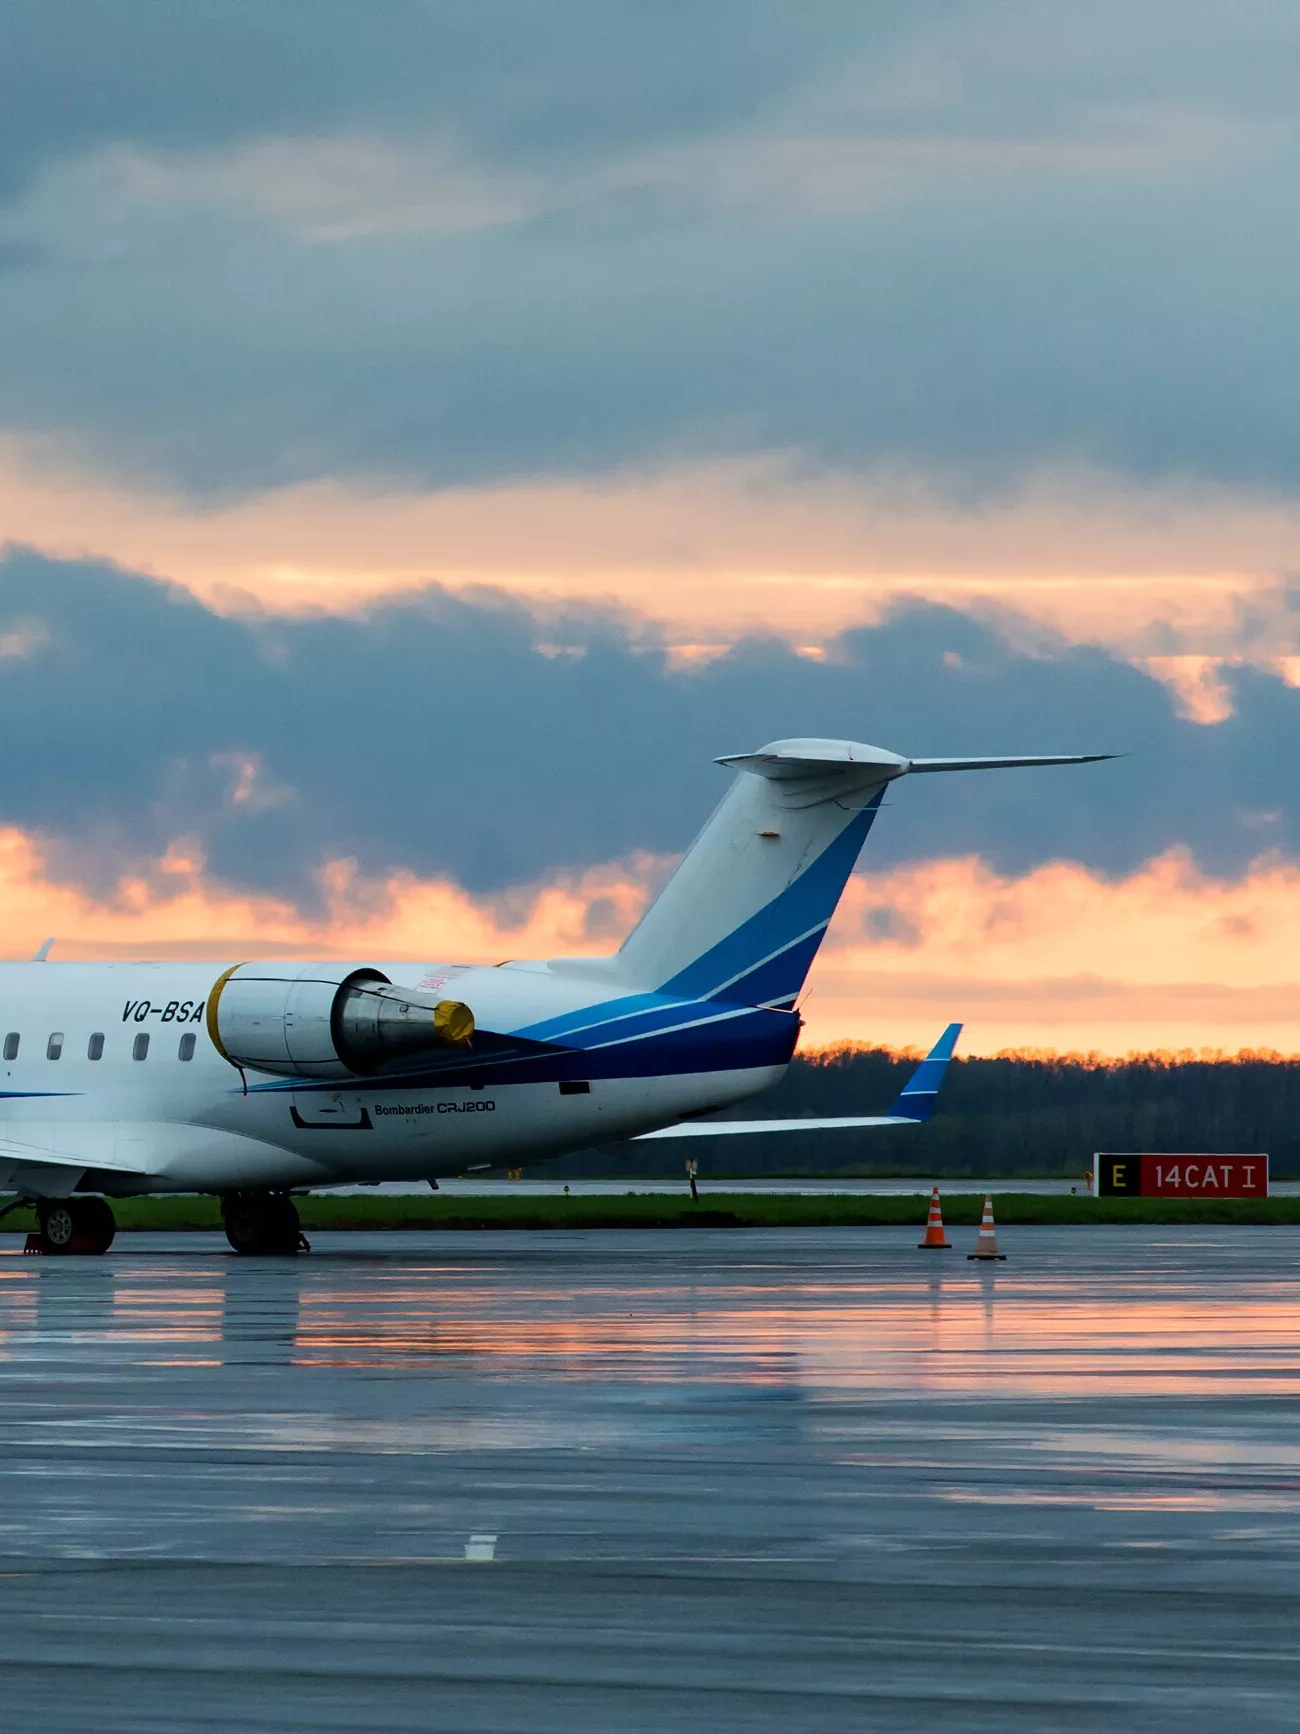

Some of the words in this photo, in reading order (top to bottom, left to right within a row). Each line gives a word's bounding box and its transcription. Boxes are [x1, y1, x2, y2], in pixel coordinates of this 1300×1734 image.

[122, 1000, 206, 1023] VQ-BSA
[374, 1104, 435, 1116] Bombardier
[436, 1100, 496, 1114] CRJ200
[1112, 1164, 1127, 1188] E
[1242, 1165, 1256, 1188] I
